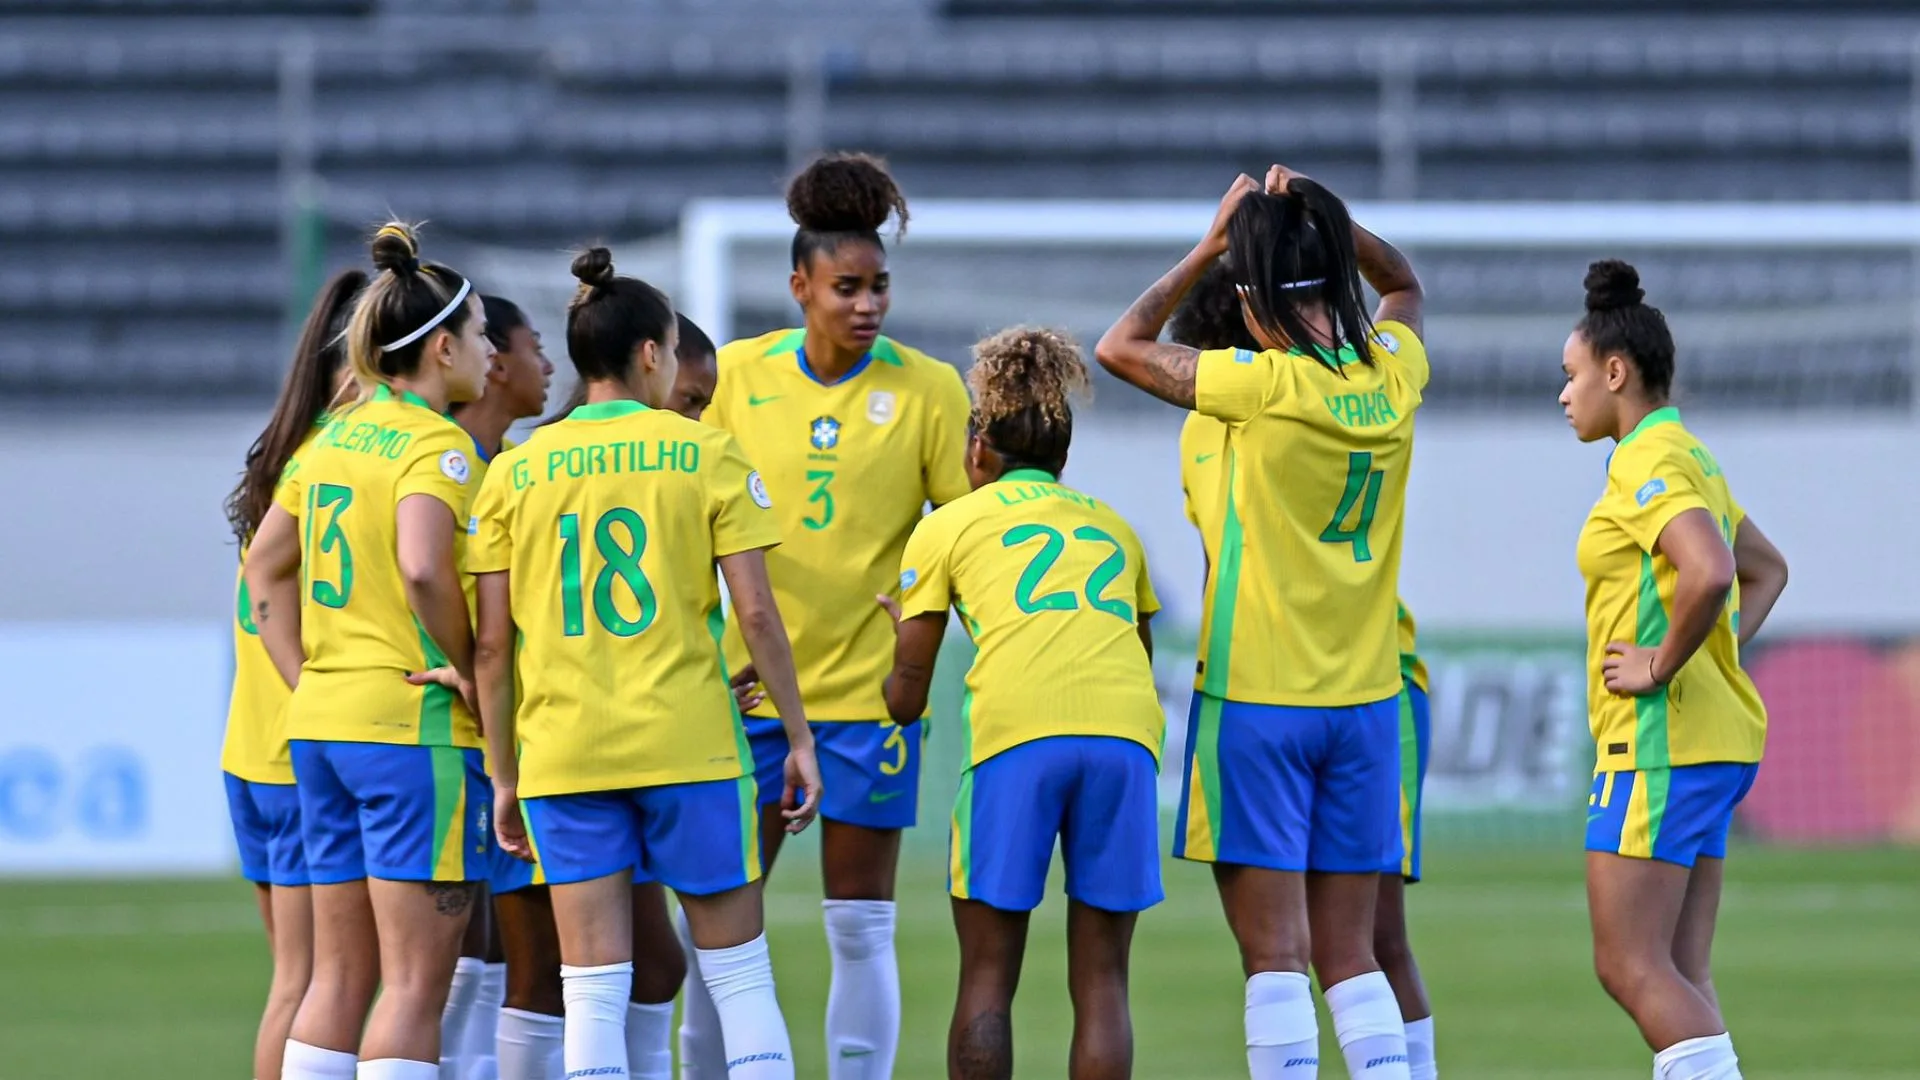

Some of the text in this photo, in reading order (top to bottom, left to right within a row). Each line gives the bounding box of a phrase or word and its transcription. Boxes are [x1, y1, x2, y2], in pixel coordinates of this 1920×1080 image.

[512, 440, 700, 490] G. PORTILHO
[802, 470, 835, 530] 3
[1319, 452, 1384, 562] 4
[303, 483, 354, 609] 13
[560, 507, 657, 637] 18
[1001, 523, 1134, 624] 22
[879, 719, 907, 775] 3
